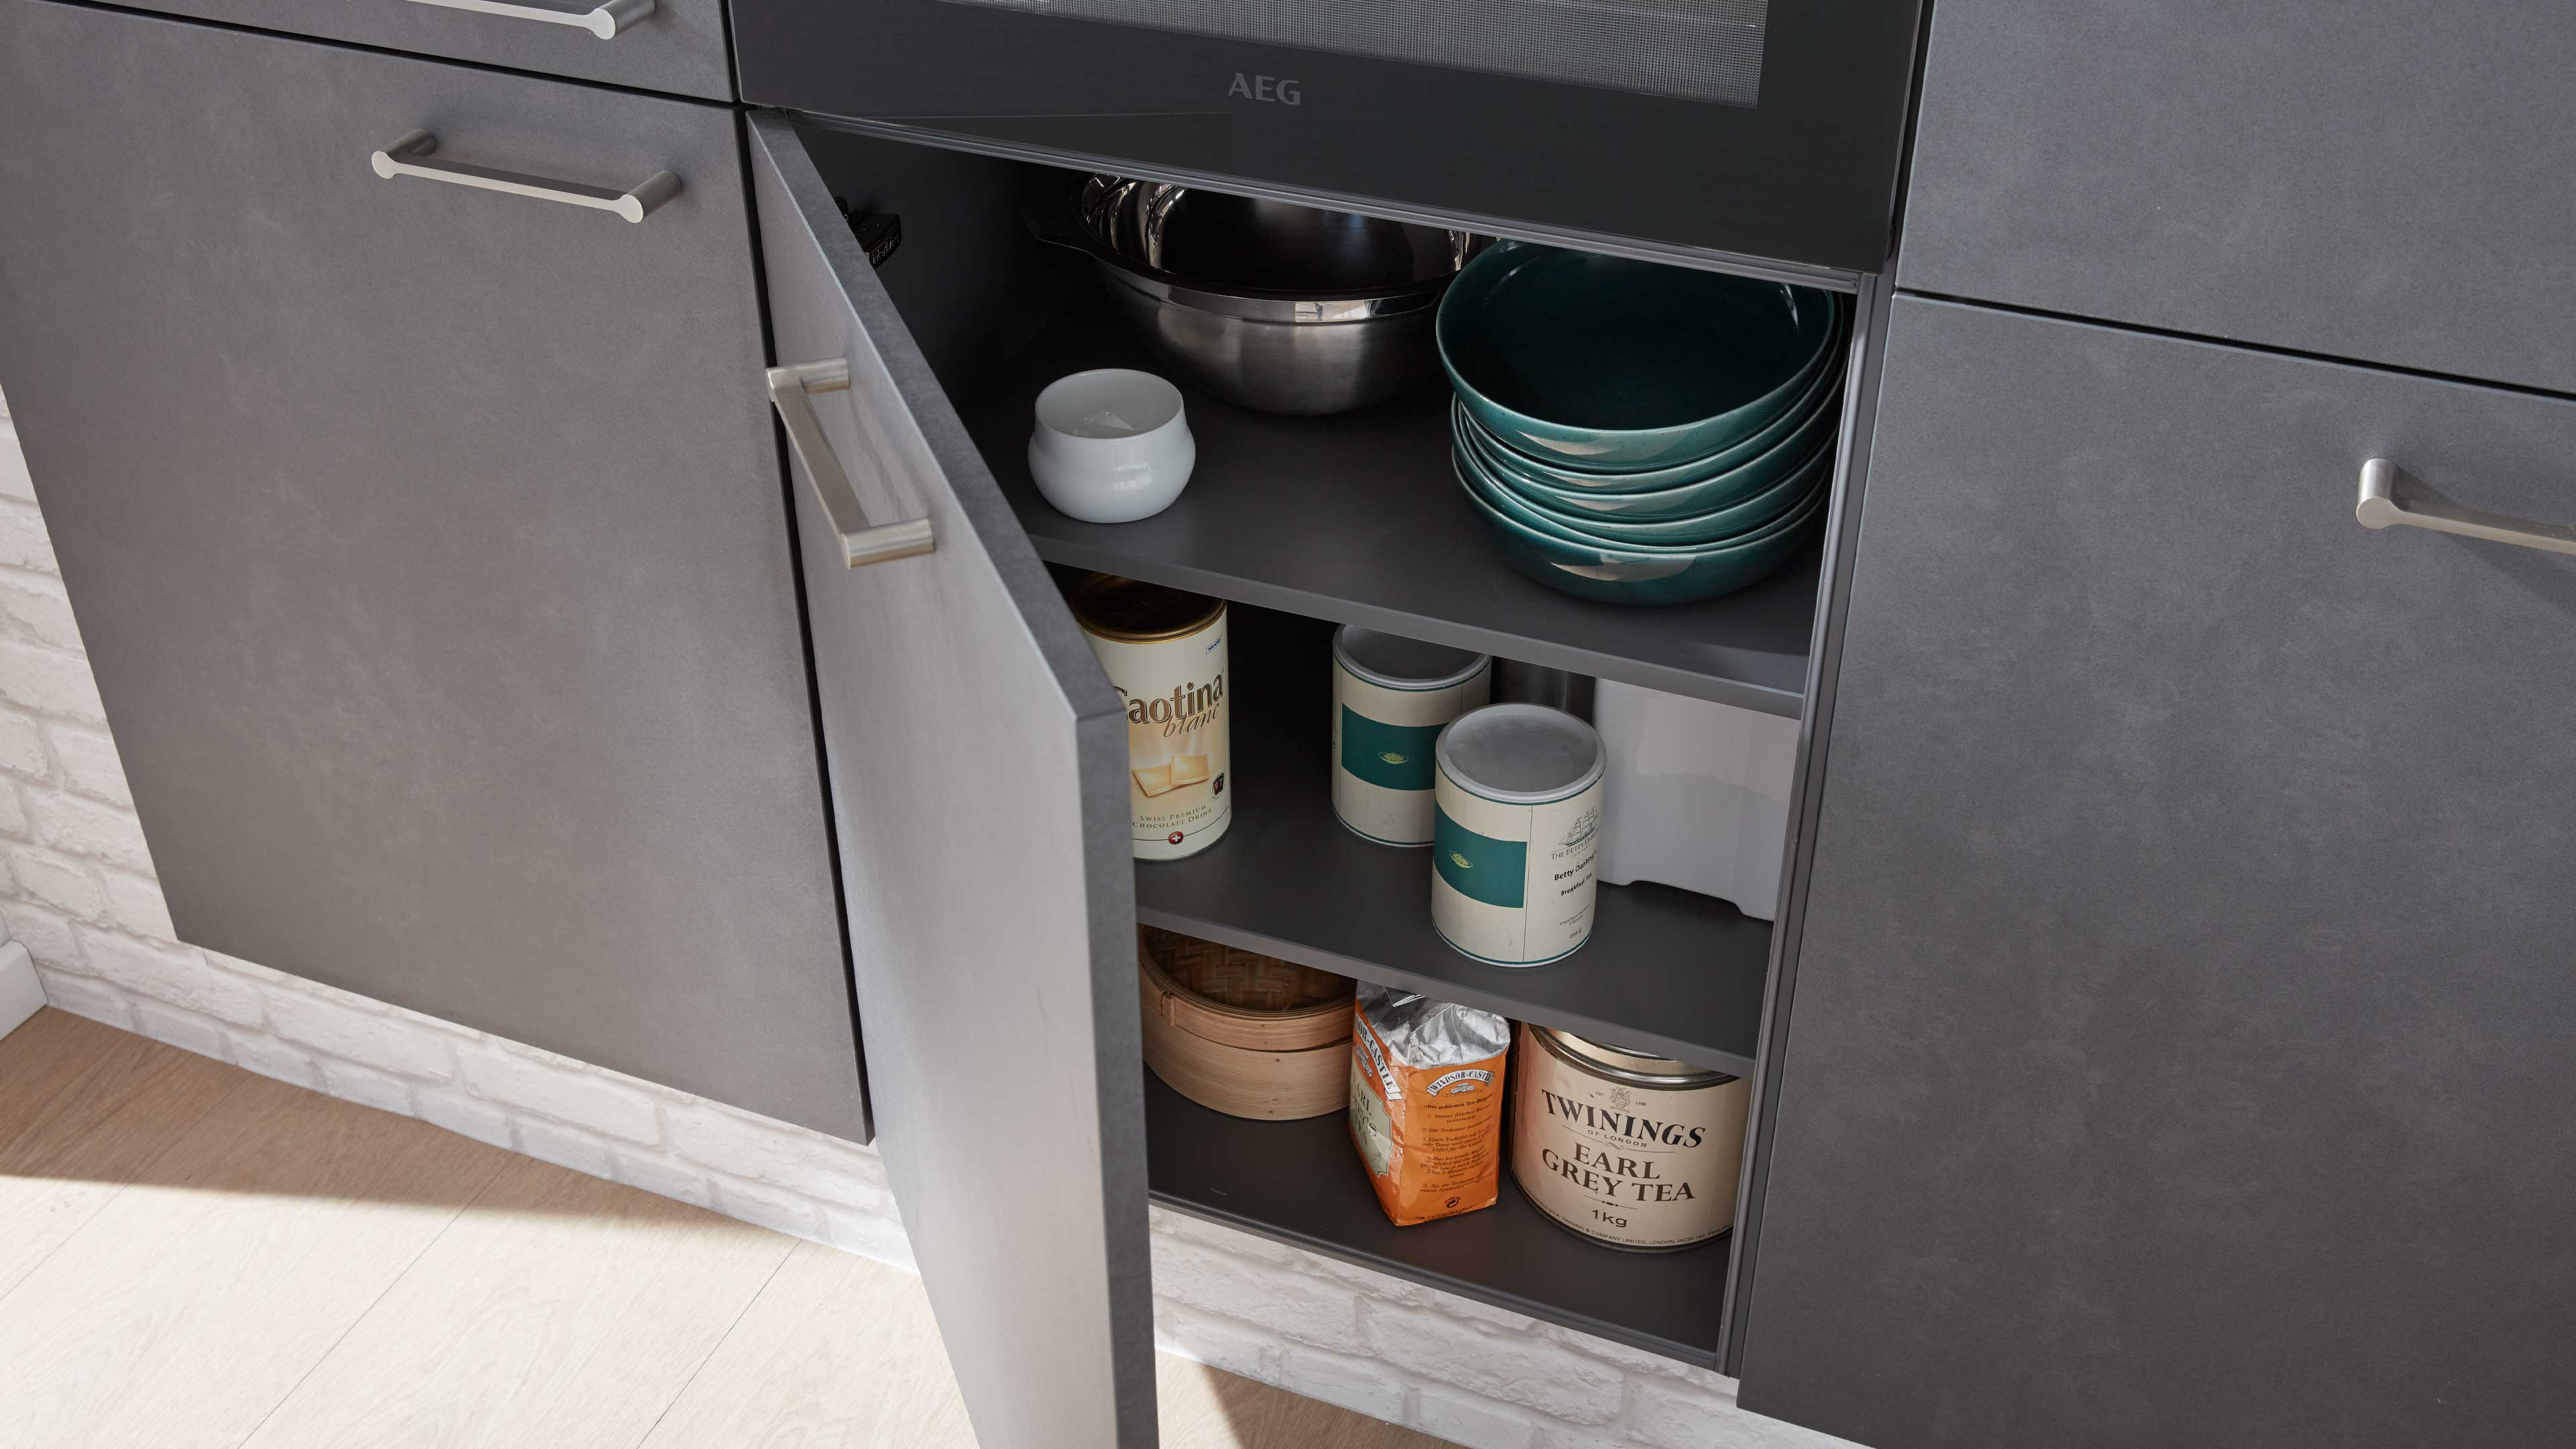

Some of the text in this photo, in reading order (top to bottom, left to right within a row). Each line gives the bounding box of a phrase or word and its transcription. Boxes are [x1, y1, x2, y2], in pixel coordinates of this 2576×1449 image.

[1228, 72, 1301, 105] AEG
[1163, 703, 1220, 738] blanc
[1554, 869, 1574, 881] Betty
[1561, 879, 1585, 896] Breakfast
[1355, 1015, 1396, 1089] SOR-CASTLE
[1430, 1071, 1491, 1091] WINDSOR-CASTLE
[1542, 1089, 1706, 1148] TWININGS
[1604, 1134, 1647, 1148] LONDON
[1542, 1148, 1696, 1201] GREY TEA
[1574, 1142, 1660, 1179] EARL
[1562, 1216, 1585, 1230] TWINING
[1591, 1230, 1621, 1241] COMPANY
[1592, 1209, 1627, 1228] 1kg
